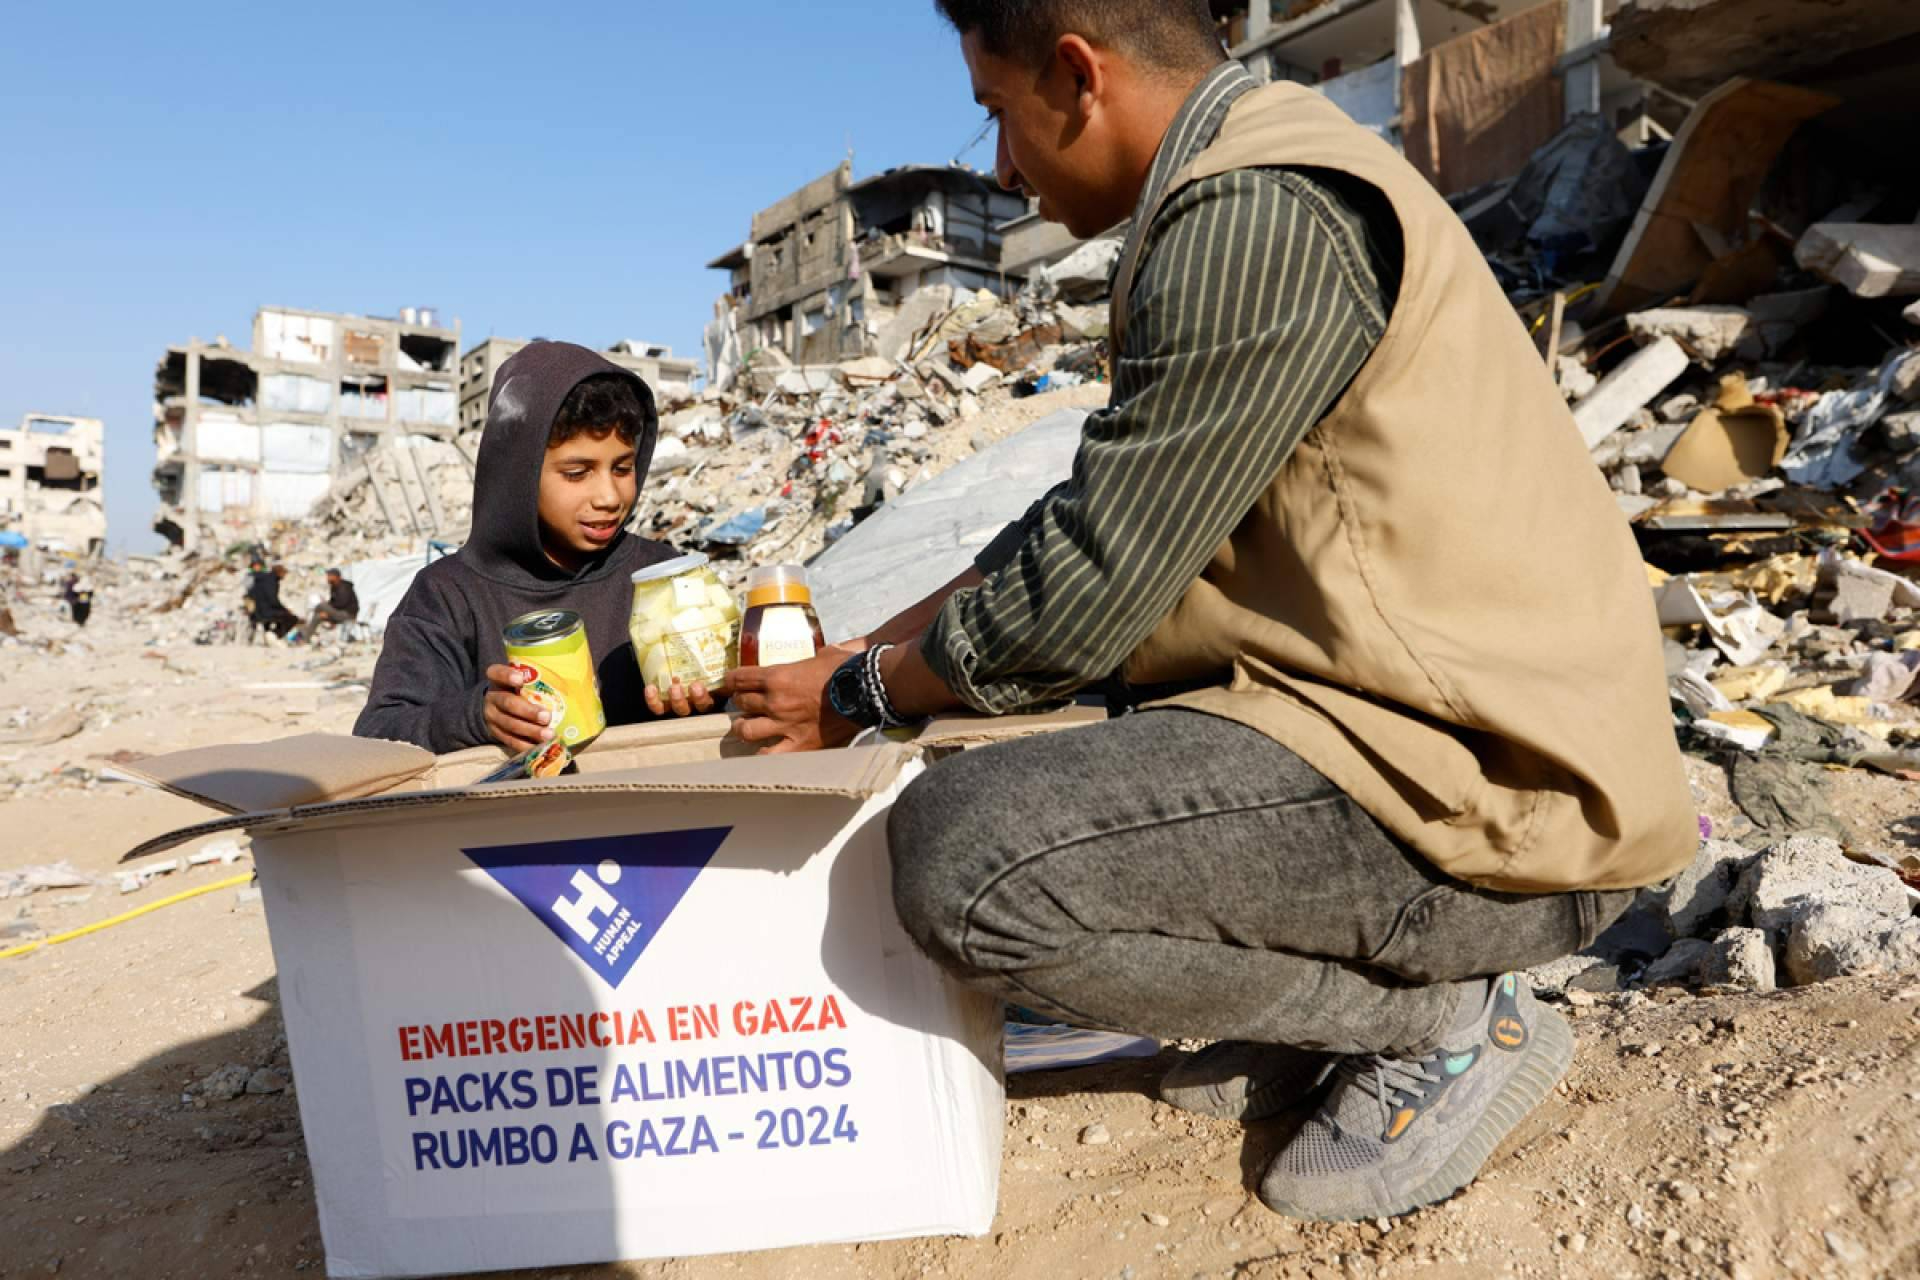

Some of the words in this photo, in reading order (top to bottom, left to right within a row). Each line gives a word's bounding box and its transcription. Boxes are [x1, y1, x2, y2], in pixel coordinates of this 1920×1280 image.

[594, 908, 632, 955] HUMAN
[606, 921, 642, 966] APPEAL
[398, 1010, 656, 1060] EMERGENCIA
[667, 1004, 720, 1040] EN
[732, 995, 847, 1036] GAZA
[405, 1069, 538, 1116] PACKS
[546, 1066, 600, 1106] DE
[611, 1048, 852, 1103] ALIMENTOS
[412, 1124, 557, 1170] RUMBO
[569, 1122, 599, 1162] A
[606, 1115, 719, 1160] GAZA
[755, 1104, 858, 1150] 2024
